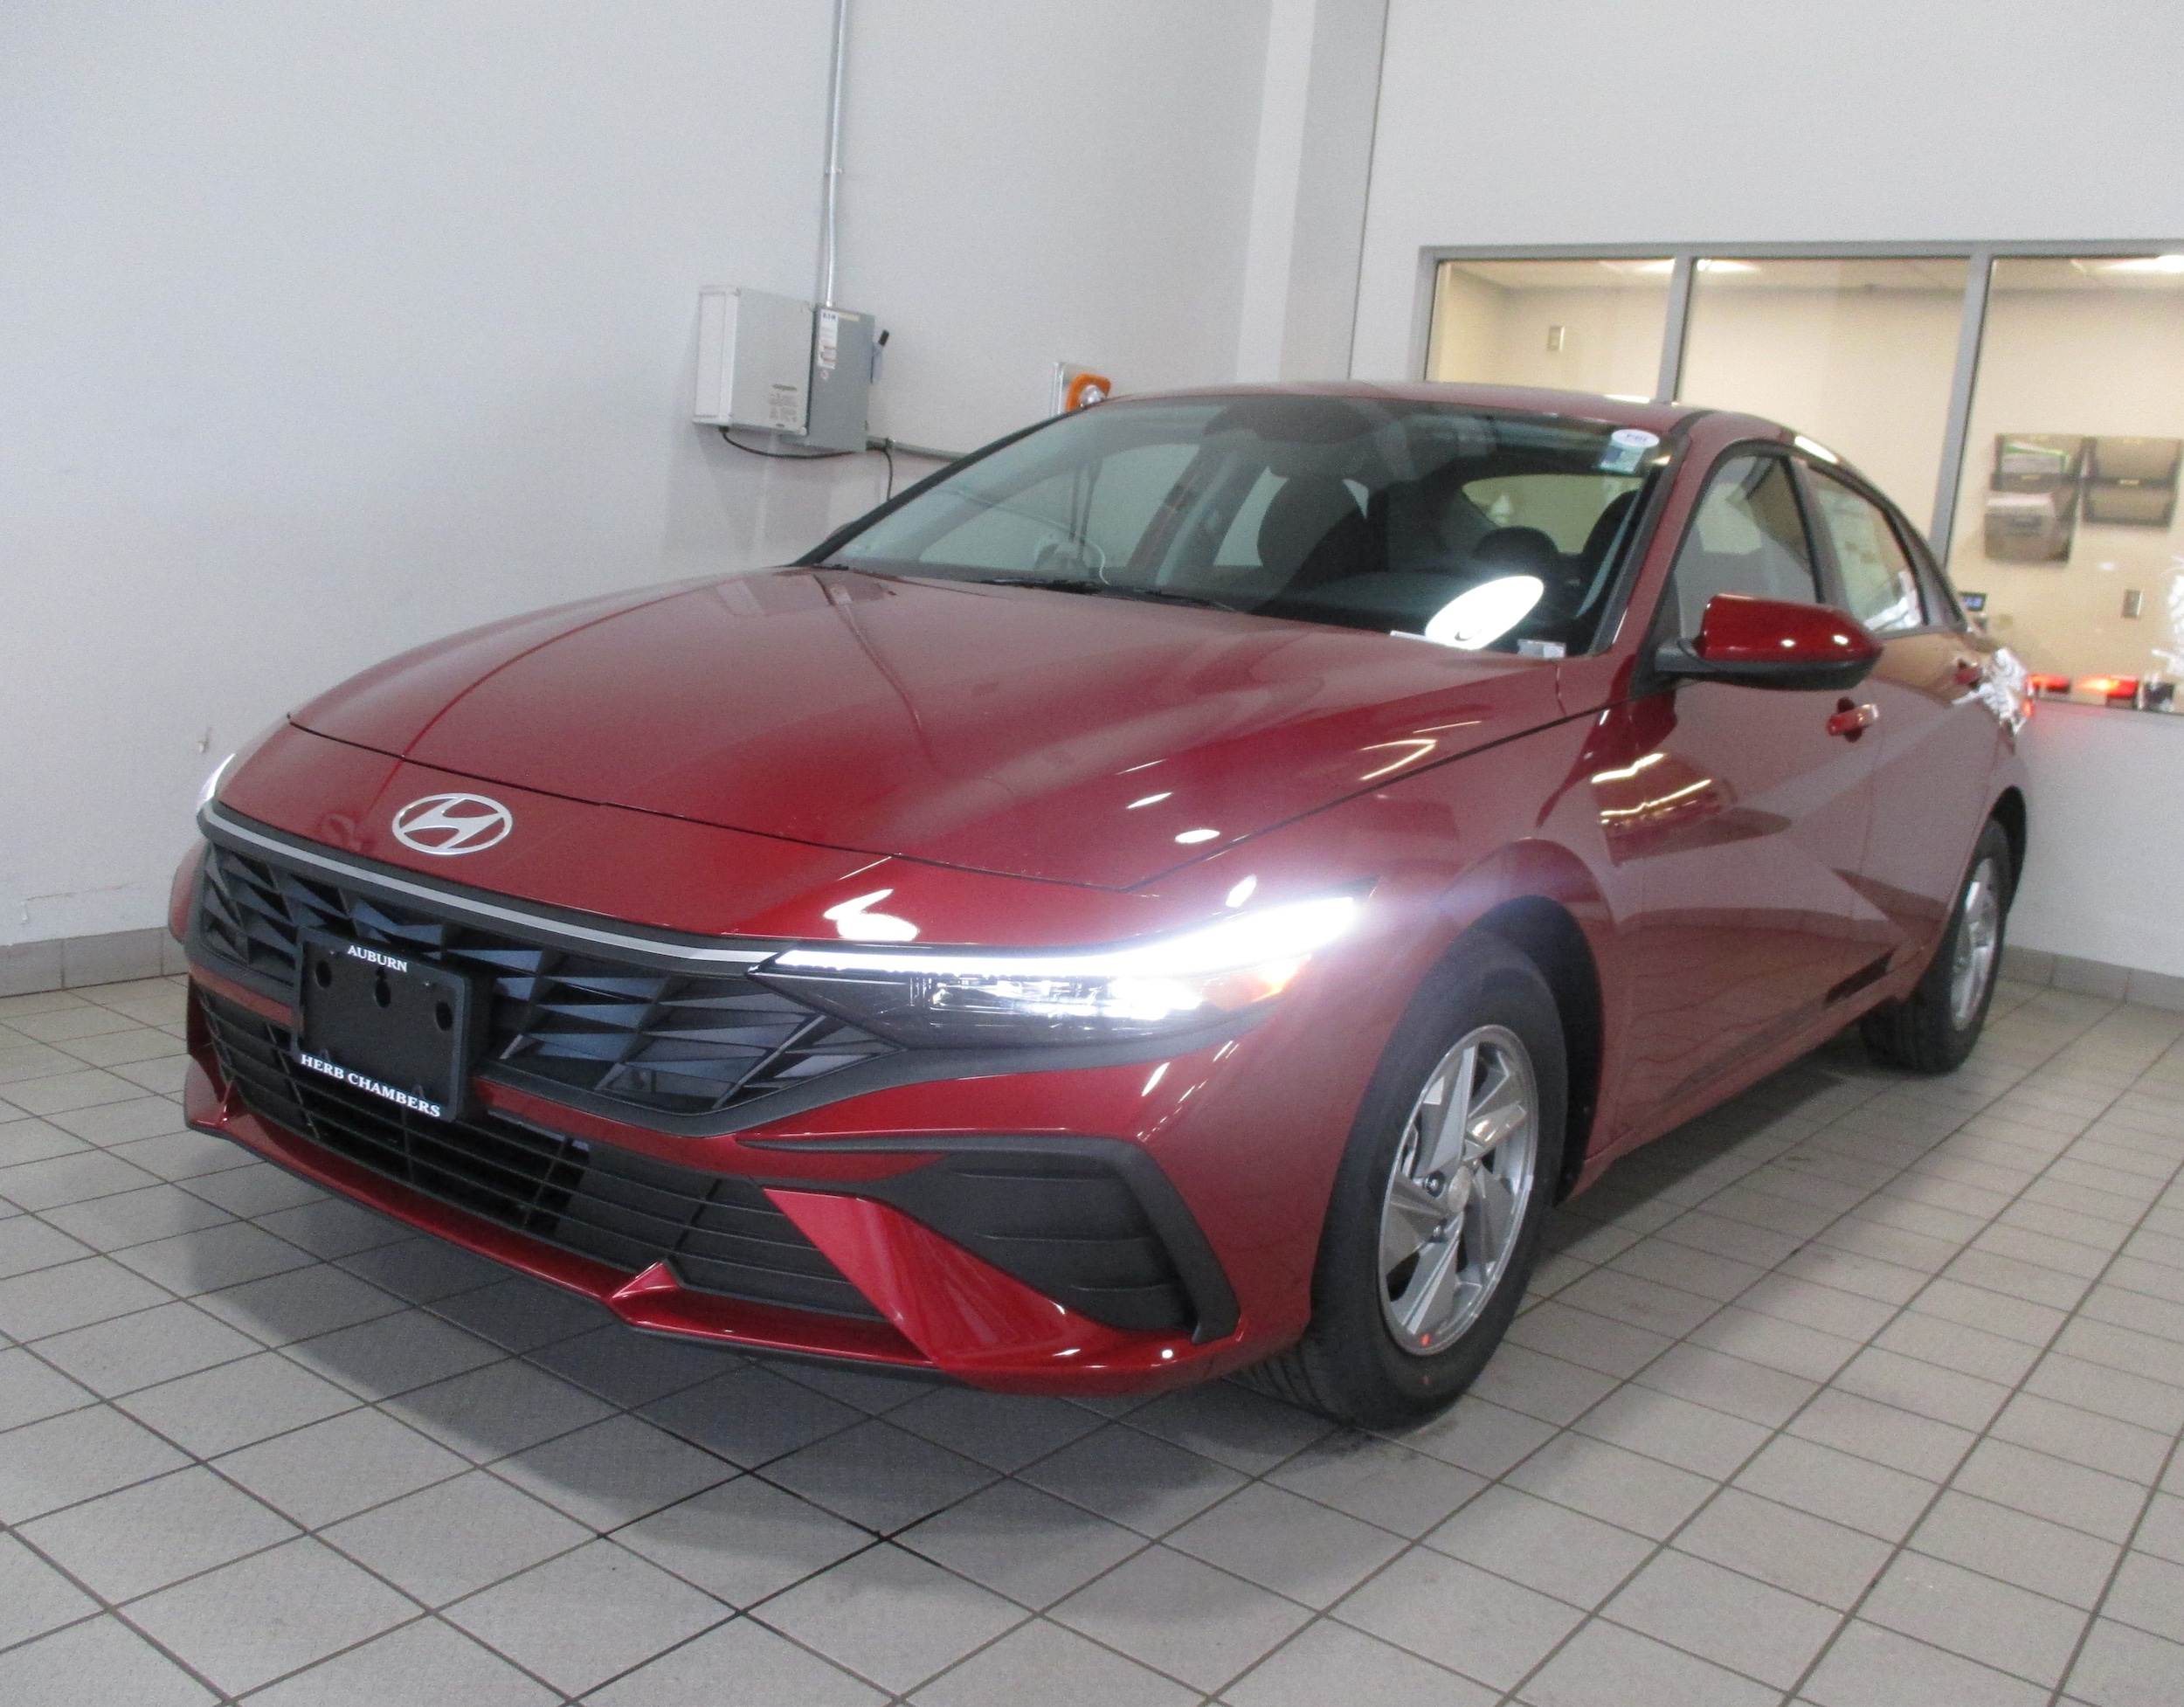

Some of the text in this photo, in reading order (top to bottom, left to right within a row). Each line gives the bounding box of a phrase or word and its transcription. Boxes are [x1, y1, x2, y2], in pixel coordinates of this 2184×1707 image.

[348, 944, 408, 972] AUBURN
[300, 1054, 441, 1117] HERB CHAMBERS
